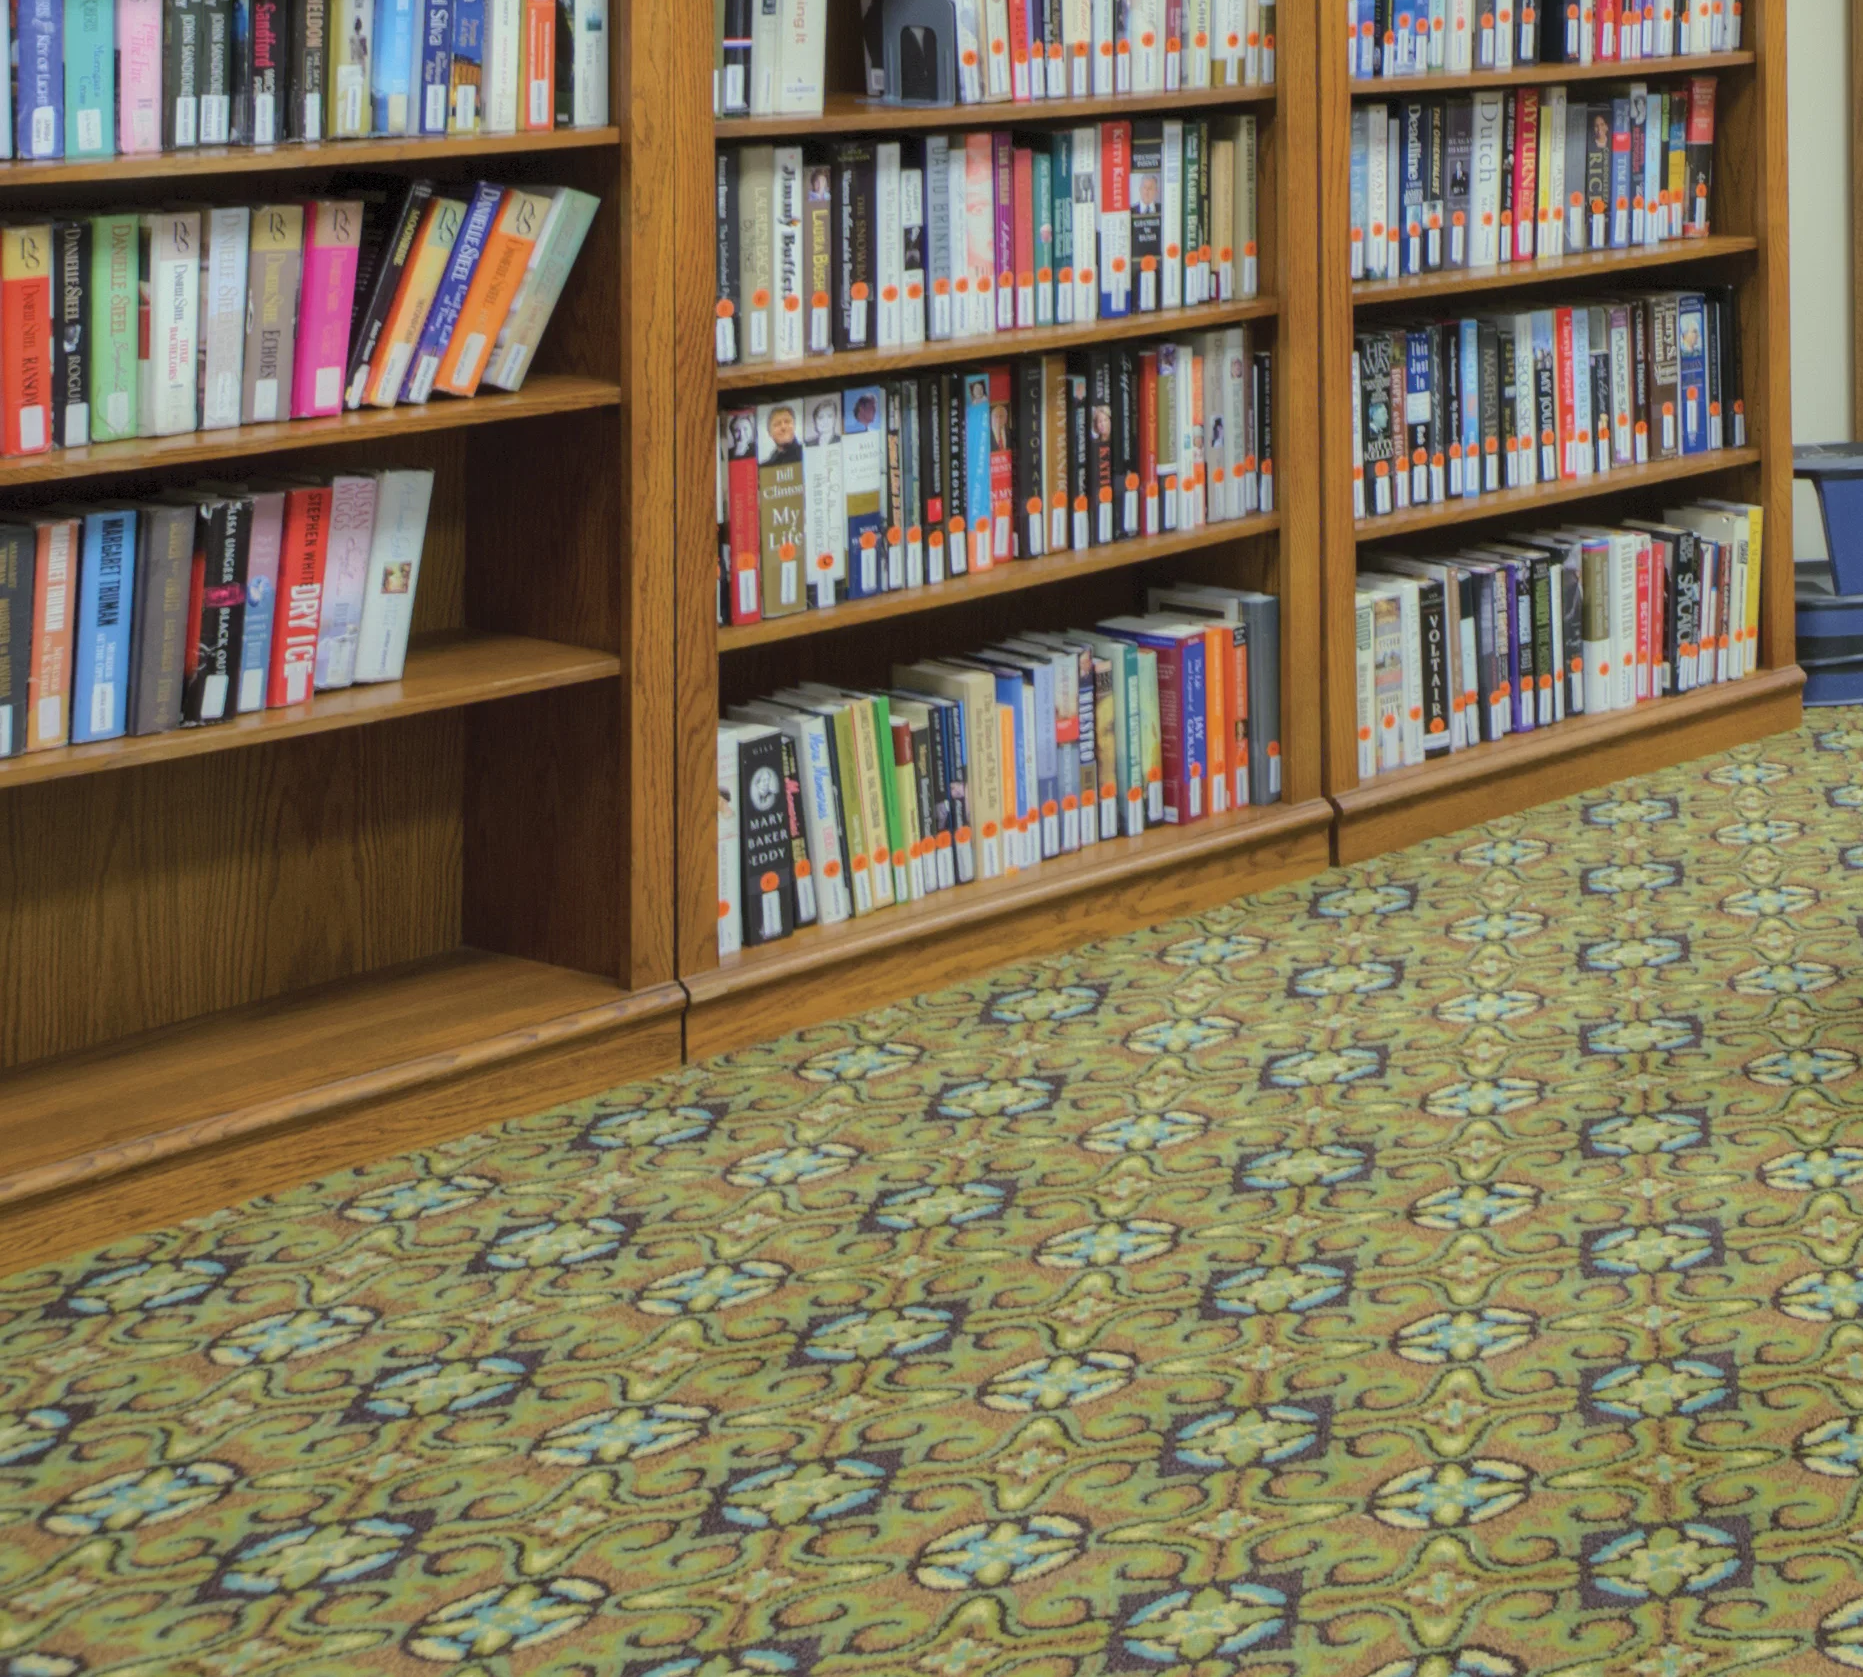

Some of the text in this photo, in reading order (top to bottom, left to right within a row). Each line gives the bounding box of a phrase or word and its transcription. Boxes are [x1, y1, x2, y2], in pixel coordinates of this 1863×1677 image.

[180, 15, 195, 43] JOHN
[254, 3, 276, 66] Sandford
[429, 10, 448, 46] Silva
[796, 34, 808, 44] It
[1407, 105, 1421, 180] Deadline
[1479, 99, 1498, 183] Dutch
[1521, 95, 1536, 187] MY TURN
[1187, 164, 1198, 250] MABEL BELL
[451, 188, 500, 283] DANIELLE STEEL
[812, 209, 828, 291] LAURA BUSH
[110, 223, 131, 337] DANIELLE STEEL
[260, 330, 280, 379] ECHOES
[1654, 306, 1664, 362] Truman
[20, 357, 39, 405] RANSOM
[1484, 349, 1495, 419] MARTHA
[1540, 371, 1551, 392] MY
[1577, 319, 1587, 420] SOLDIER GIRLS
[763, 484, 804, 499] Clinton
[224, 509, 238, 536] LISA
[305, 494, 322, 547] STEPHEN
[769, 528, 803, 551] Life
[772, 507, 800, 531] My
[97, 519, 123, 627] MARGARET TRUMAN
[222, 538, 236, 583] UNGER
[216, 608, 230, 644] BLACK
[288, 583, 321, 628] DRY
[284, 635, 314, 677] ICE
[748, 829, 788, 850] BAKER
[750, 812, 784, 831] MARY
[751, 848, 785, 866] EDDY
